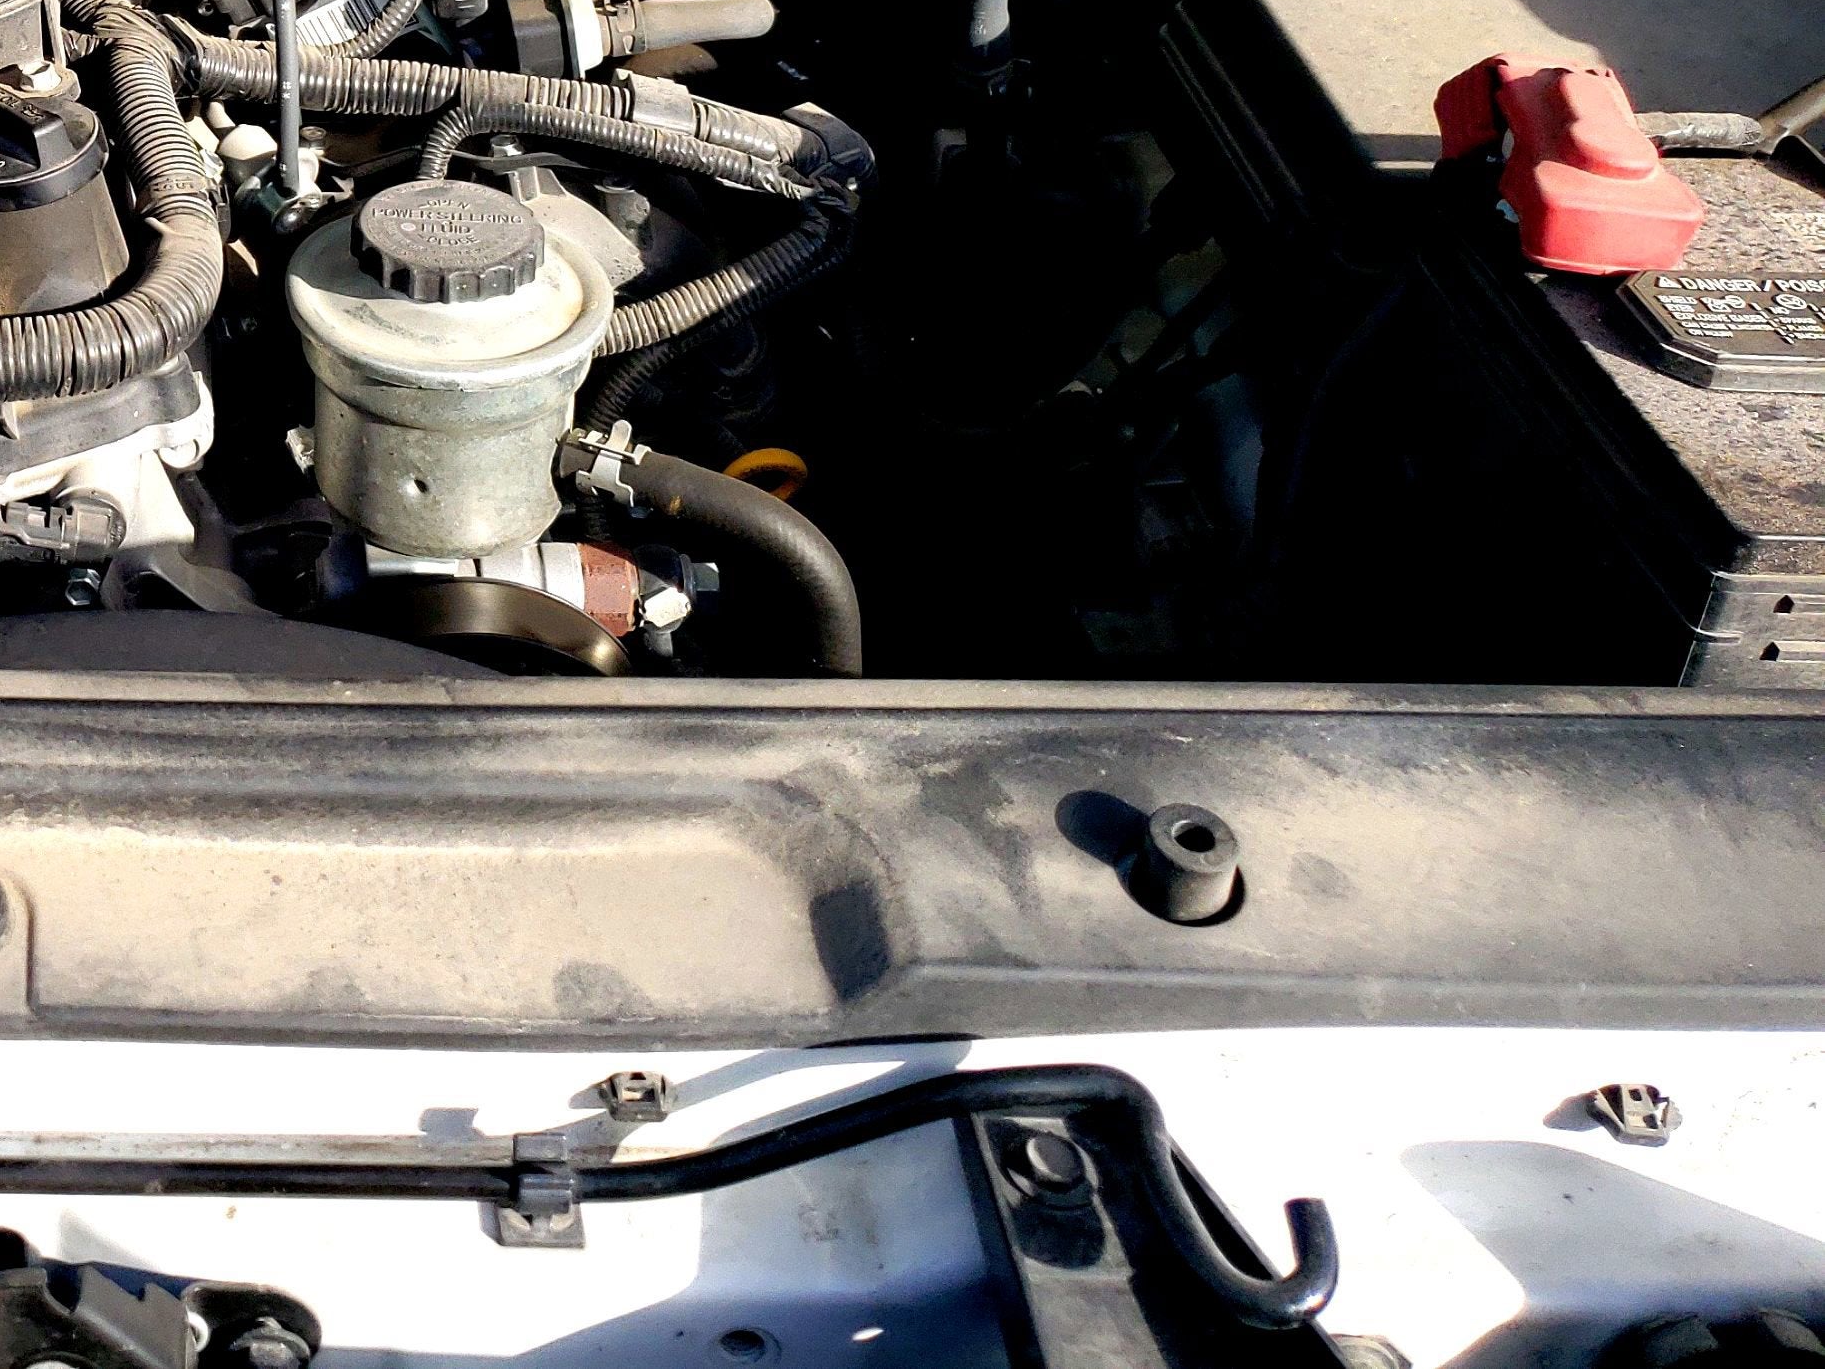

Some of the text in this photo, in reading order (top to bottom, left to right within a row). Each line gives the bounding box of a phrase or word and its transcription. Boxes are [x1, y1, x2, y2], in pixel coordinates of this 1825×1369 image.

[426, 198, 471, 210] OPEN
[372, 207, 523, 225] POWER STEERING
[420, 221, 472, 234] FLUID
[425, 234, 480, 246] CLOSE
[1679, 278, 1761, 292] DANGER
